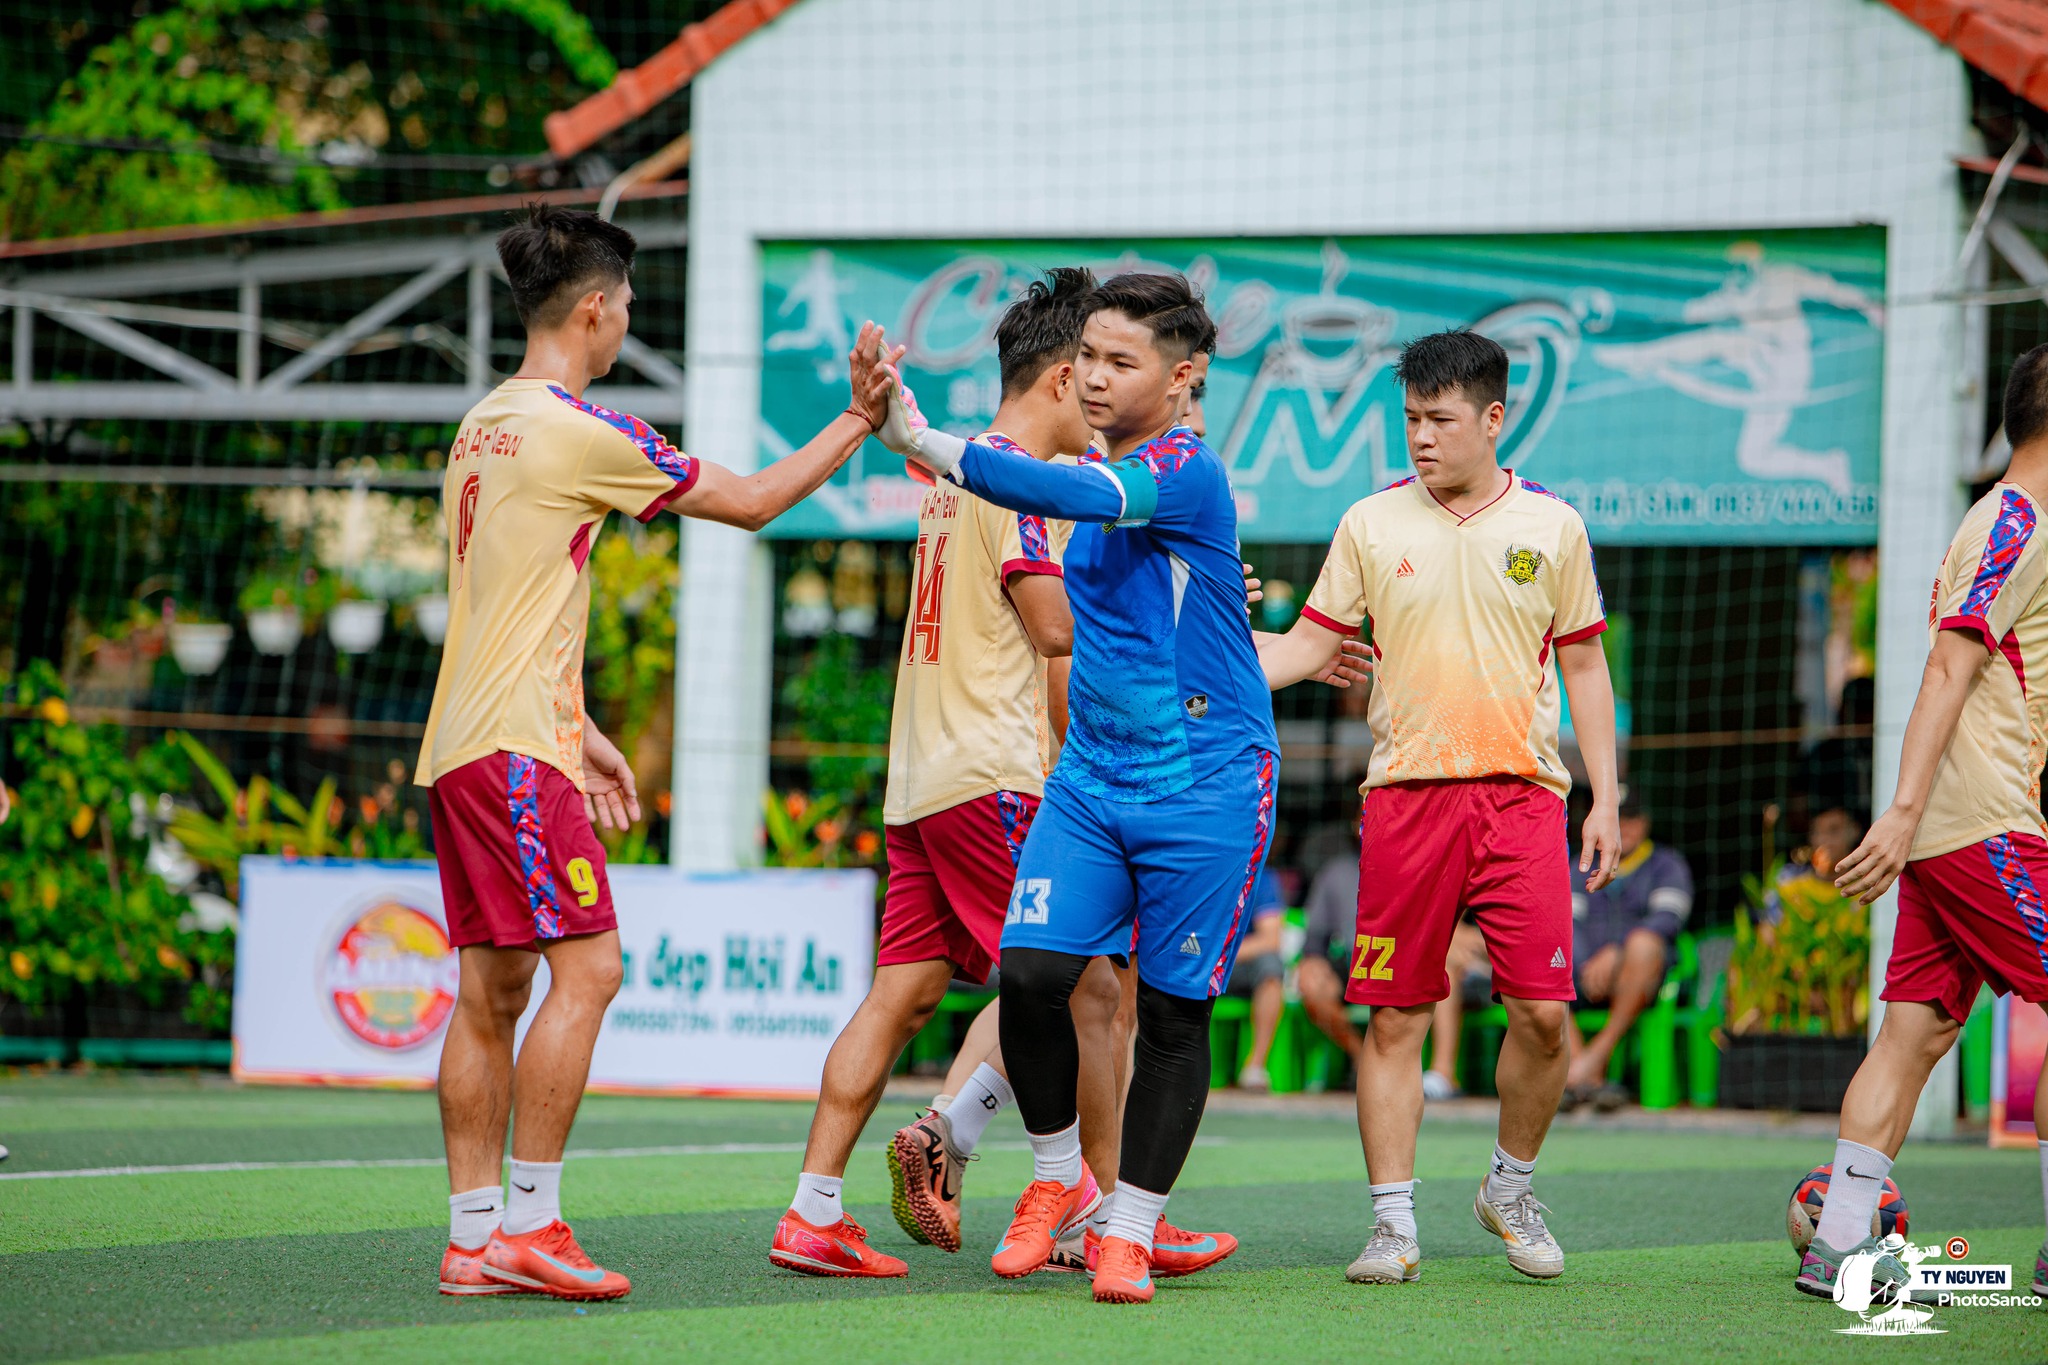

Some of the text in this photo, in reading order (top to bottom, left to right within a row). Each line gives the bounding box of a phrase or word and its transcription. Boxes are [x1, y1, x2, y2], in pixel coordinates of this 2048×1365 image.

[906, 532, 950, 666] 14
[565, 856, 599, 908] 9
[1005, 878, 1052, 926] 33
[1179, 947, 1202, 956] APOLLO
